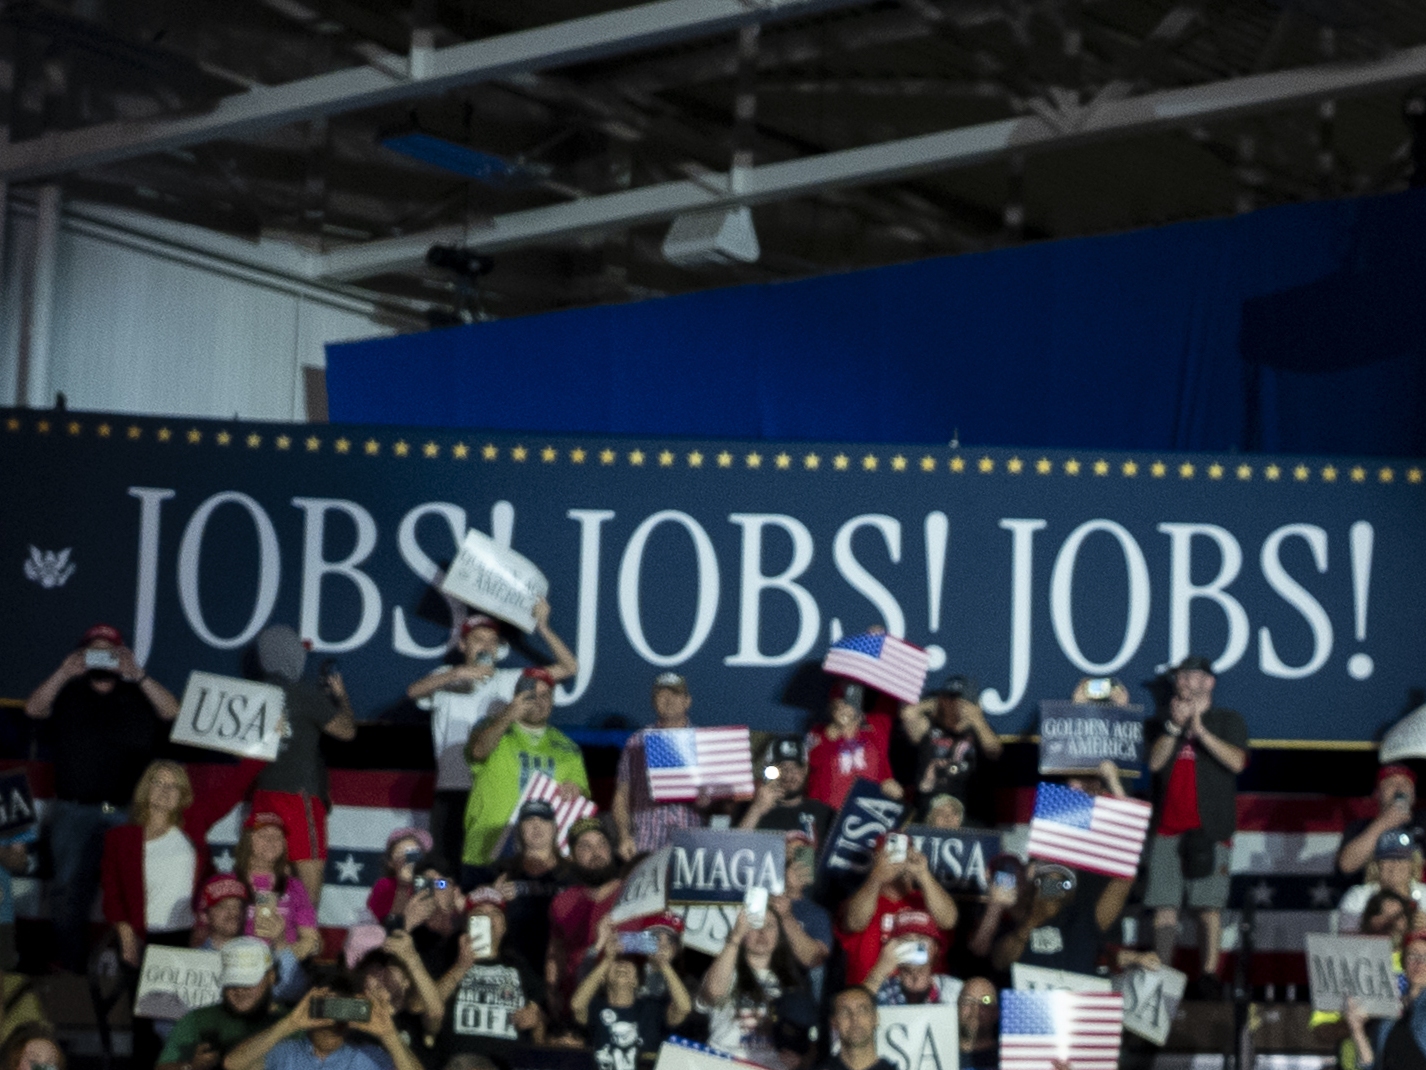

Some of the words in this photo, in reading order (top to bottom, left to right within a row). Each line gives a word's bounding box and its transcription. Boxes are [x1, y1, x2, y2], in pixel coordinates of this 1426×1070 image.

[554, 508, 949, 707] JOBS!
[980, 518, 1375, 716] JOBS!
[190, 686, 269, 744] USA
[1042, 717, 1109, 740] GOLDEN
[1067, 738, 1137, 761] AMERICA
[672, 845, 783, 894] MAGA
[1124, 968, 1164, 1029] SA
[1312, 953, 1395, 999] MAGA
